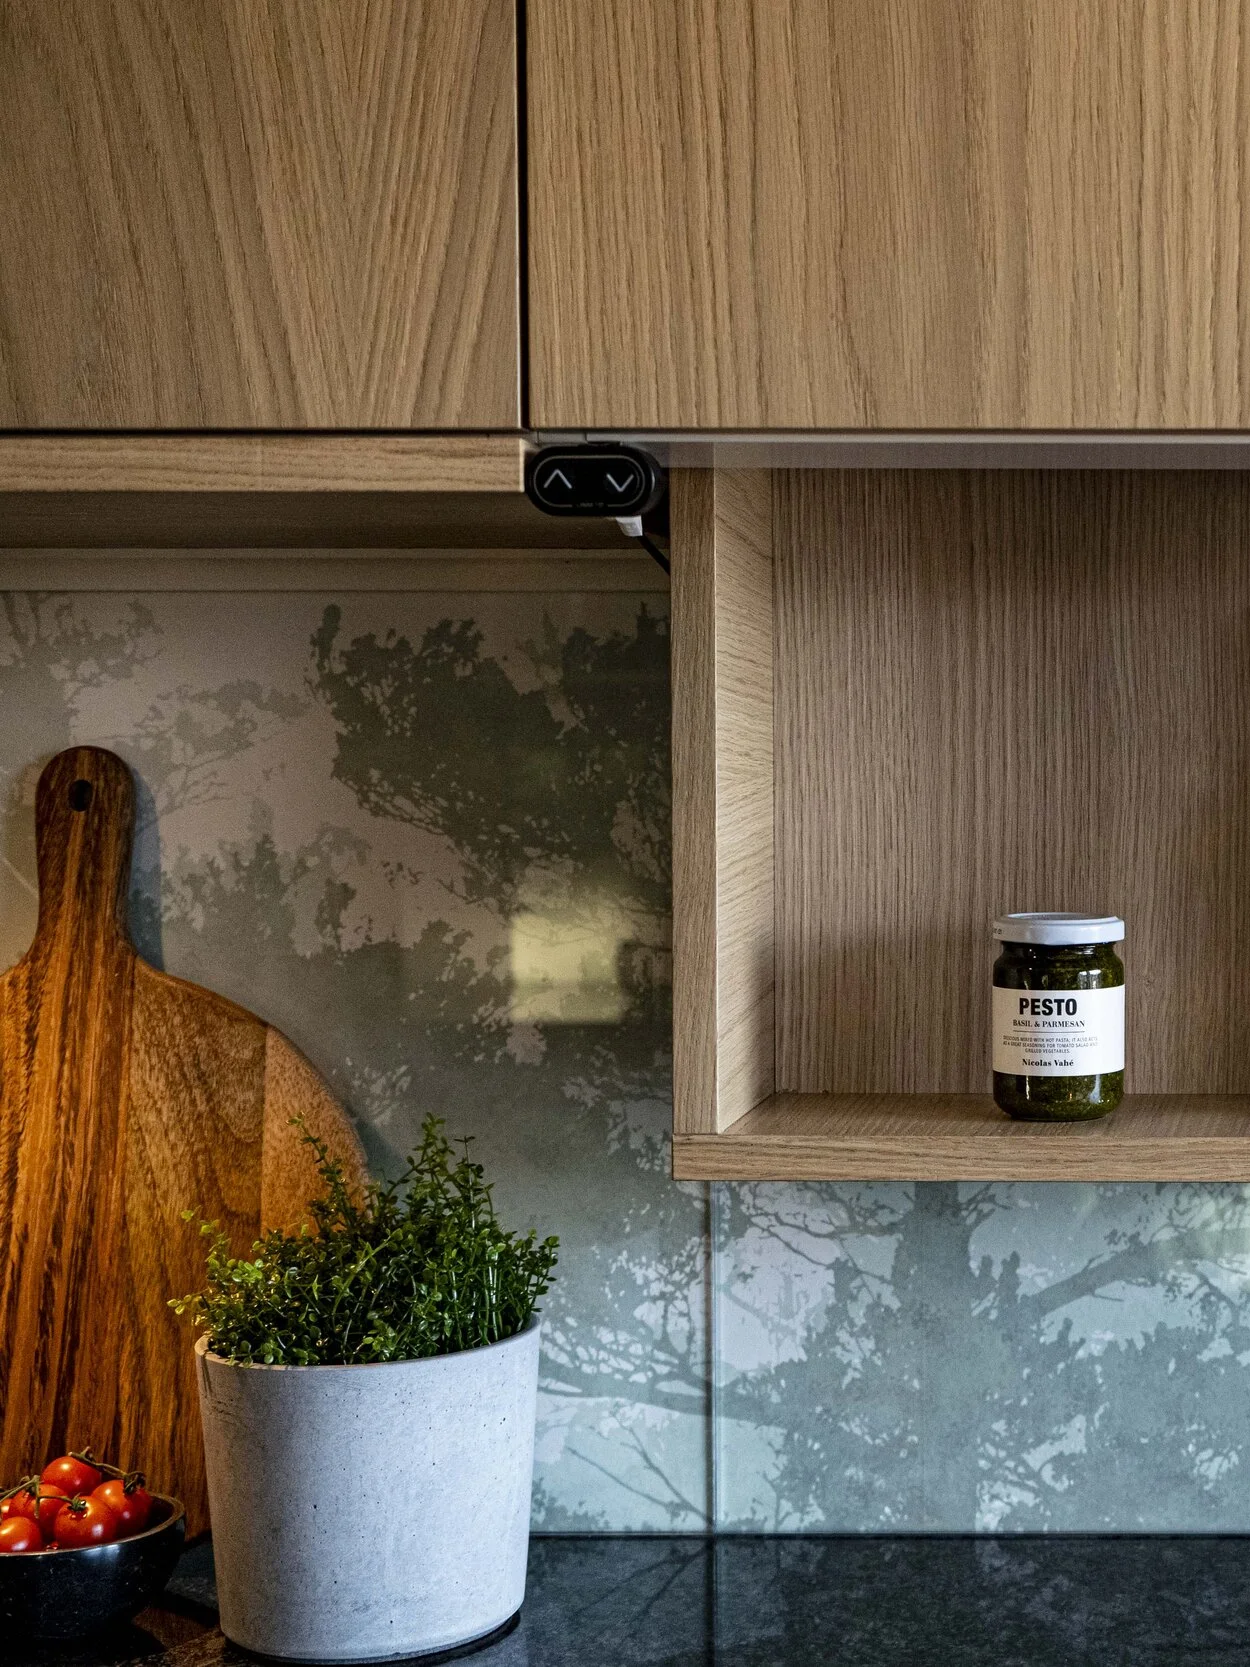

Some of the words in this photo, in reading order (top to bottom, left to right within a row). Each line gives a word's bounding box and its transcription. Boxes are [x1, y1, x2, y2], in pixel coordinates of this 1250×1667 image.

[1019, 998, 1077, 1016] PESTO
[1013, 1019, 1033, 1027] BASIL
[1042, 1020, 1085, 1028] PARMESAN
[1022, 1059, 1052, 1067] Nicolas
[1054, 1059, 1074, 1067] Vahé
